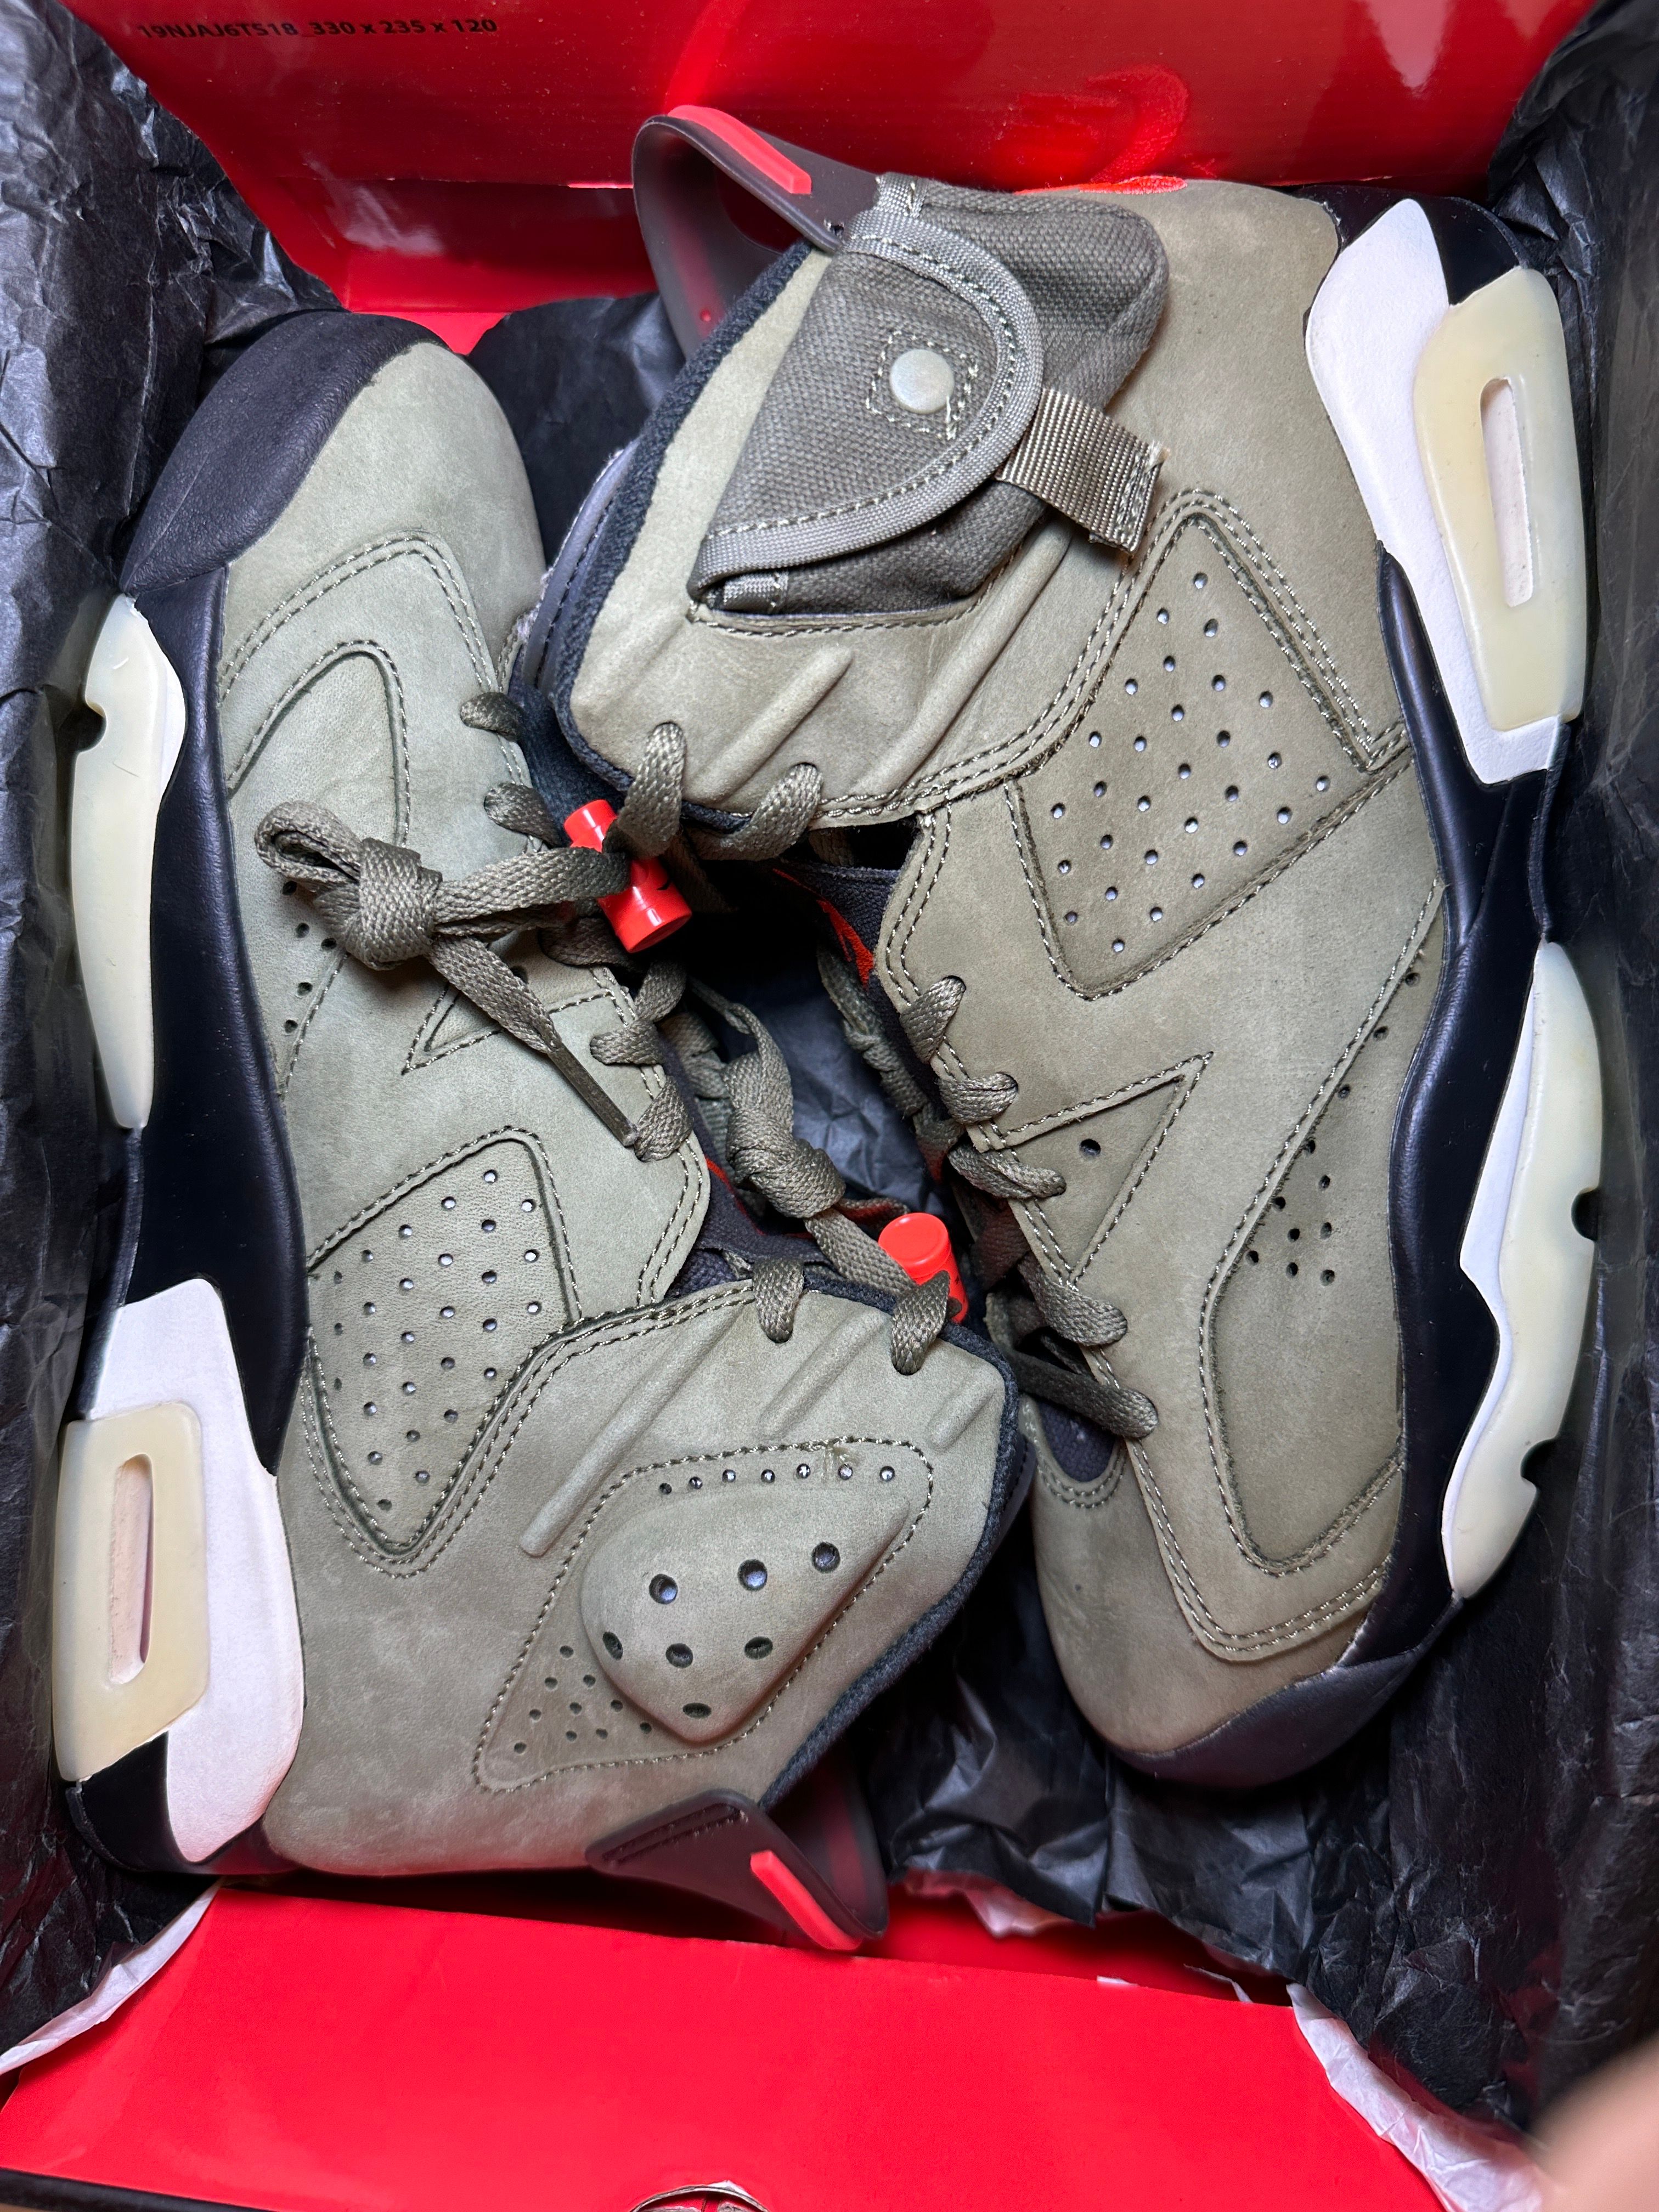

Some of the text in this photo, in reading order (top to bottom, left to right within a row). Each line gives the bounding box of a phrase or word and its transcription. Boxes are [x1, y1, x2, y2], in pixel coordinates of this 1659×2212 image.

[360, 24, 377, 34] x
[379, 19, 426, 34] 235
[430, 22, 448, 33] x
[452, 19, 497, 33] 120
